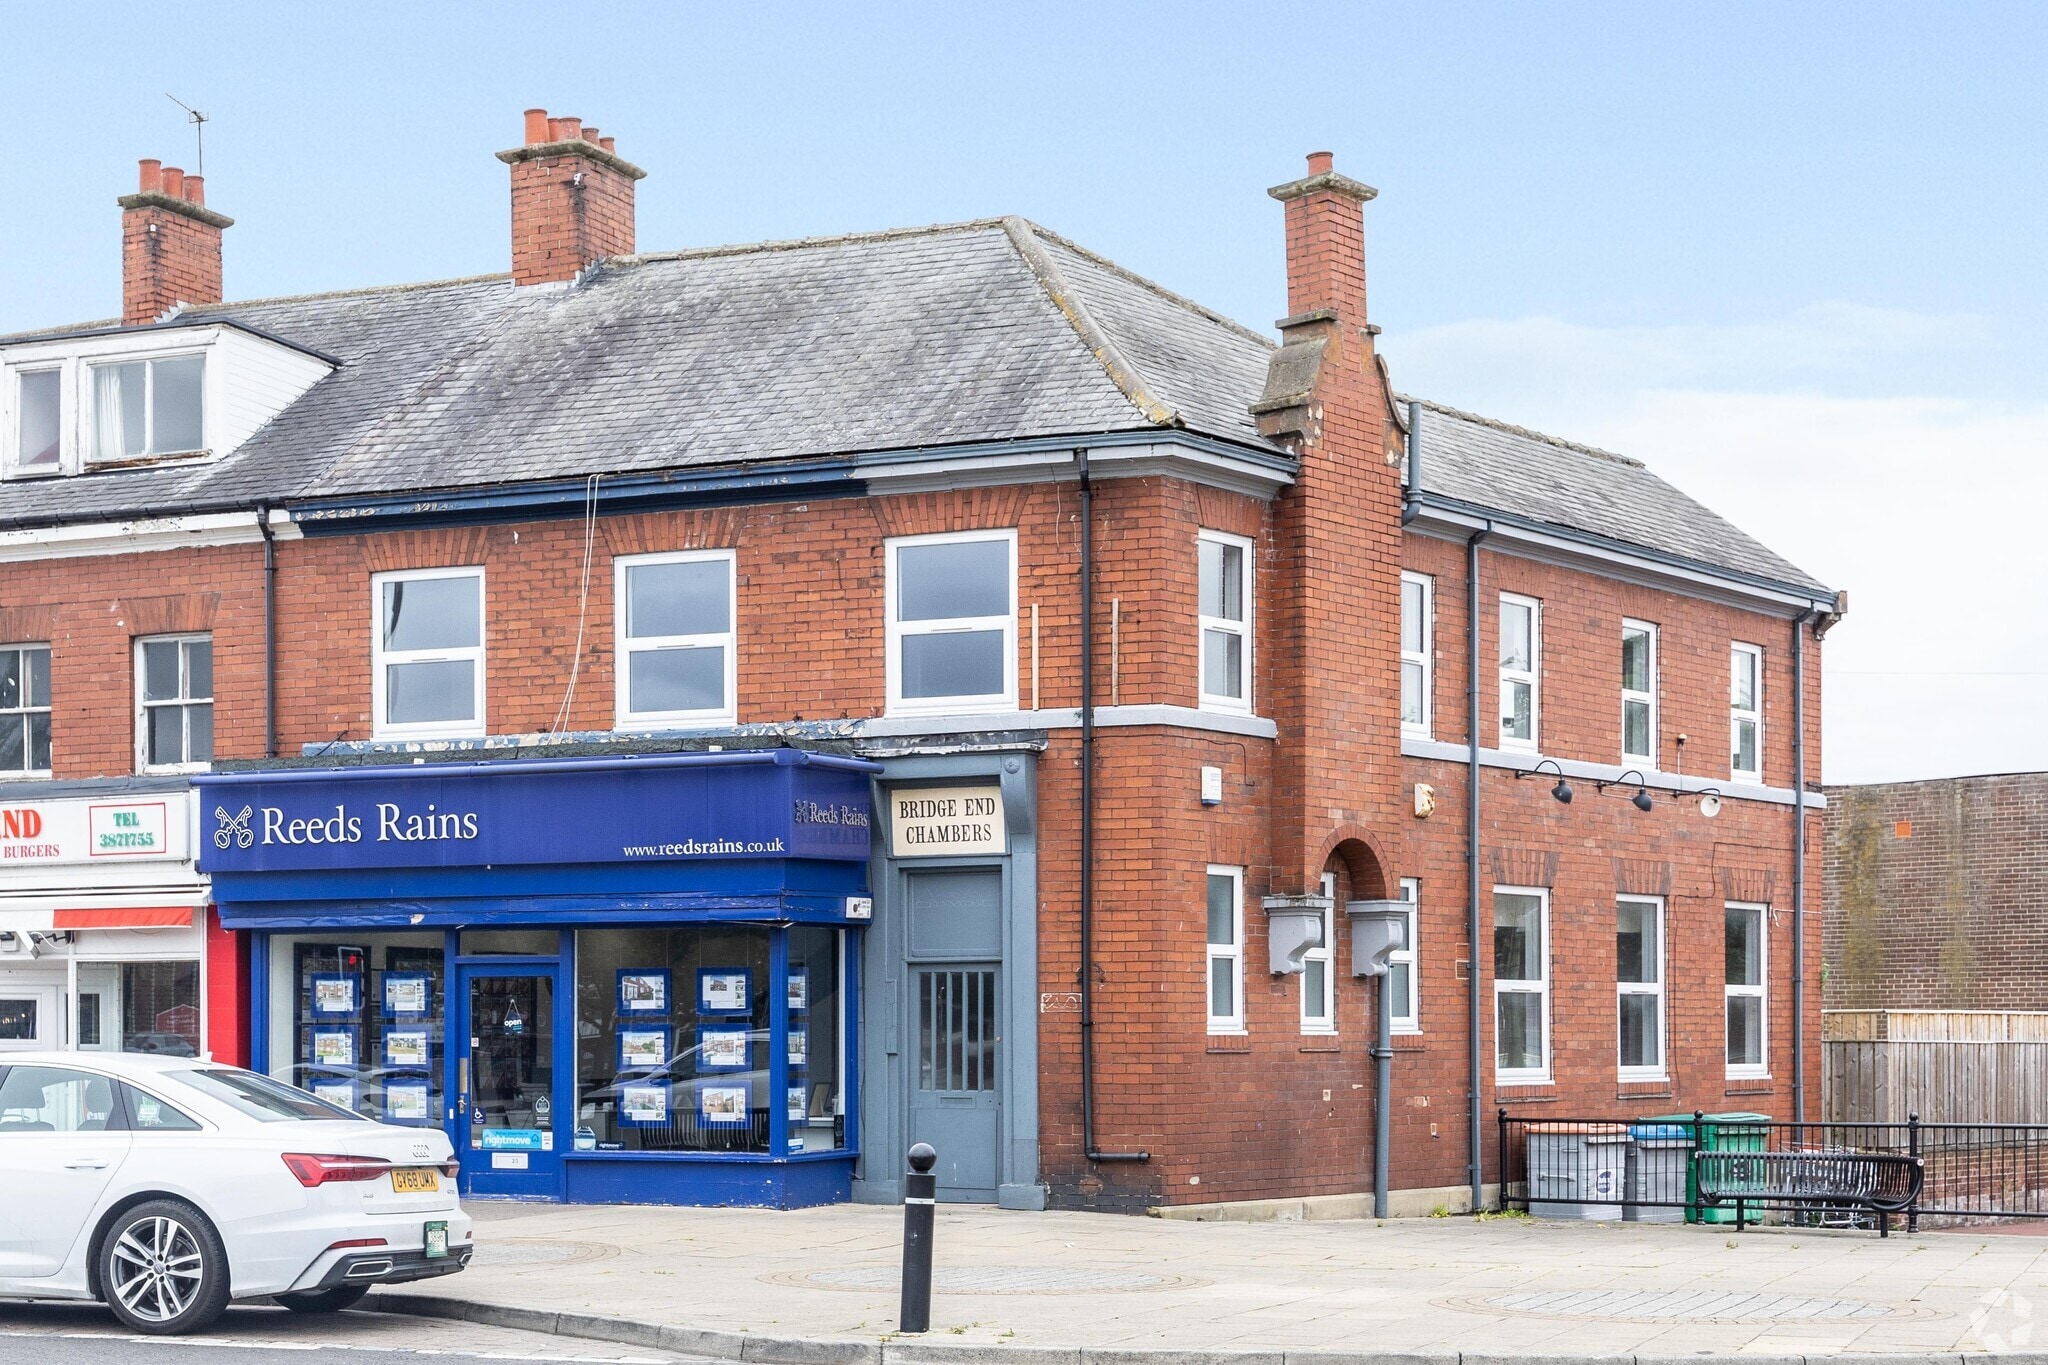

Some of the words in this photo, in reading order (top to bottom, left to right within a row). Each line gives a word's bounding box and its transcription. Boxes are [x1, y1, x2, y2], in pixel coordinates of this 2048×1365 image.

[809, 802, 839, 824] Reeds
[840, 805, 868, 827] Rains
[899, 799, 957, 819] BRIDGE
[964, 797, 995, 816] END
[0, 809, 42, 839] ND
[113, 812, 140, 827] TEL
[261, 804, 362, 845] Reeds
[376, 803, 479, 842] Rains
[99, 832, 155, 848] 3871755
[906, 824, 992, 844] CHAMBERS
[3, 844, 60, 859] BURGERS
[623, 837, 785, 857] www.reedsrains.co.uk
[504, 1019, 522, 1028] open
[485, 1134, 531, 1147] rightmove
[396, 1171, 419, 1188] GY68
